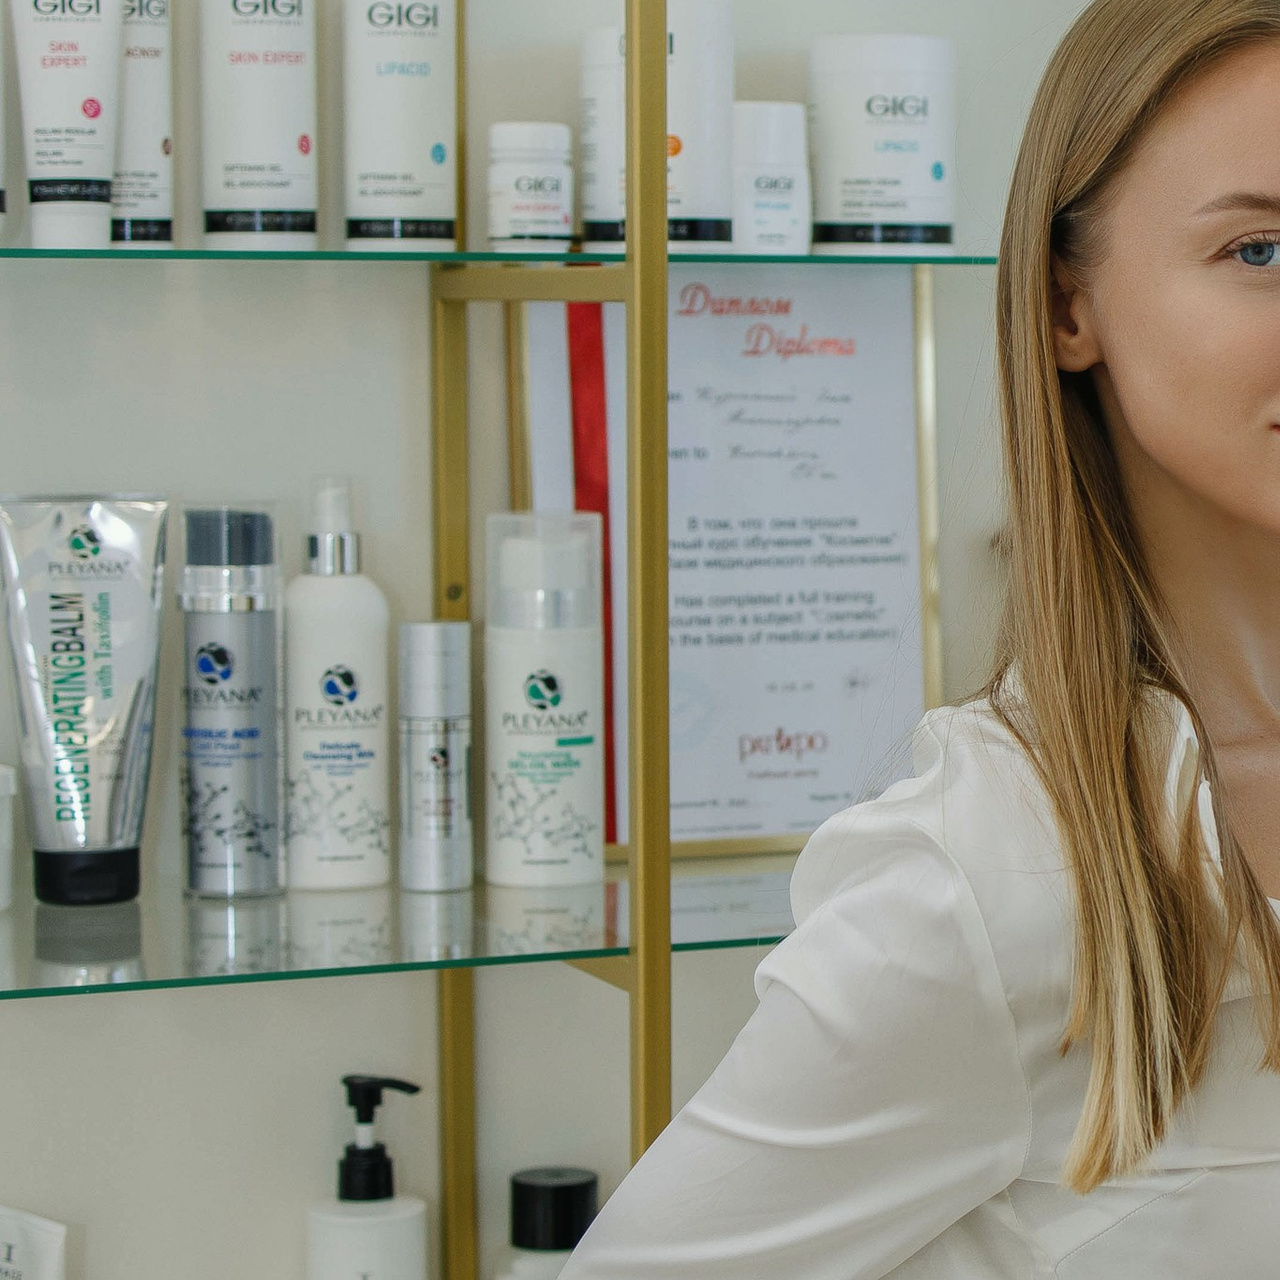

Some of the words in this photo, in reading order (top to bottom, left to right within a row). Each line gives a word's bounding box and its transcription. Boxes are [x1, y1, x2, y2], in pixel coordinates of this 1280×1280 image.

[367, 2, 438, 28] GIGI
[866, 95, 929, 117] GIGI
[514, 176, 561, 193] GIGI
[755, 176, 794, 190] GIGI
[742, 322, 855, 359] Diploma
[708, 592, 782, 608] completed
[752, 610, 803, 626] subject
[766, 629, 820, 642] medical
[295, 707, 378, 723] PLEYANA
[502, 712, 584, 727] PLEYANA
